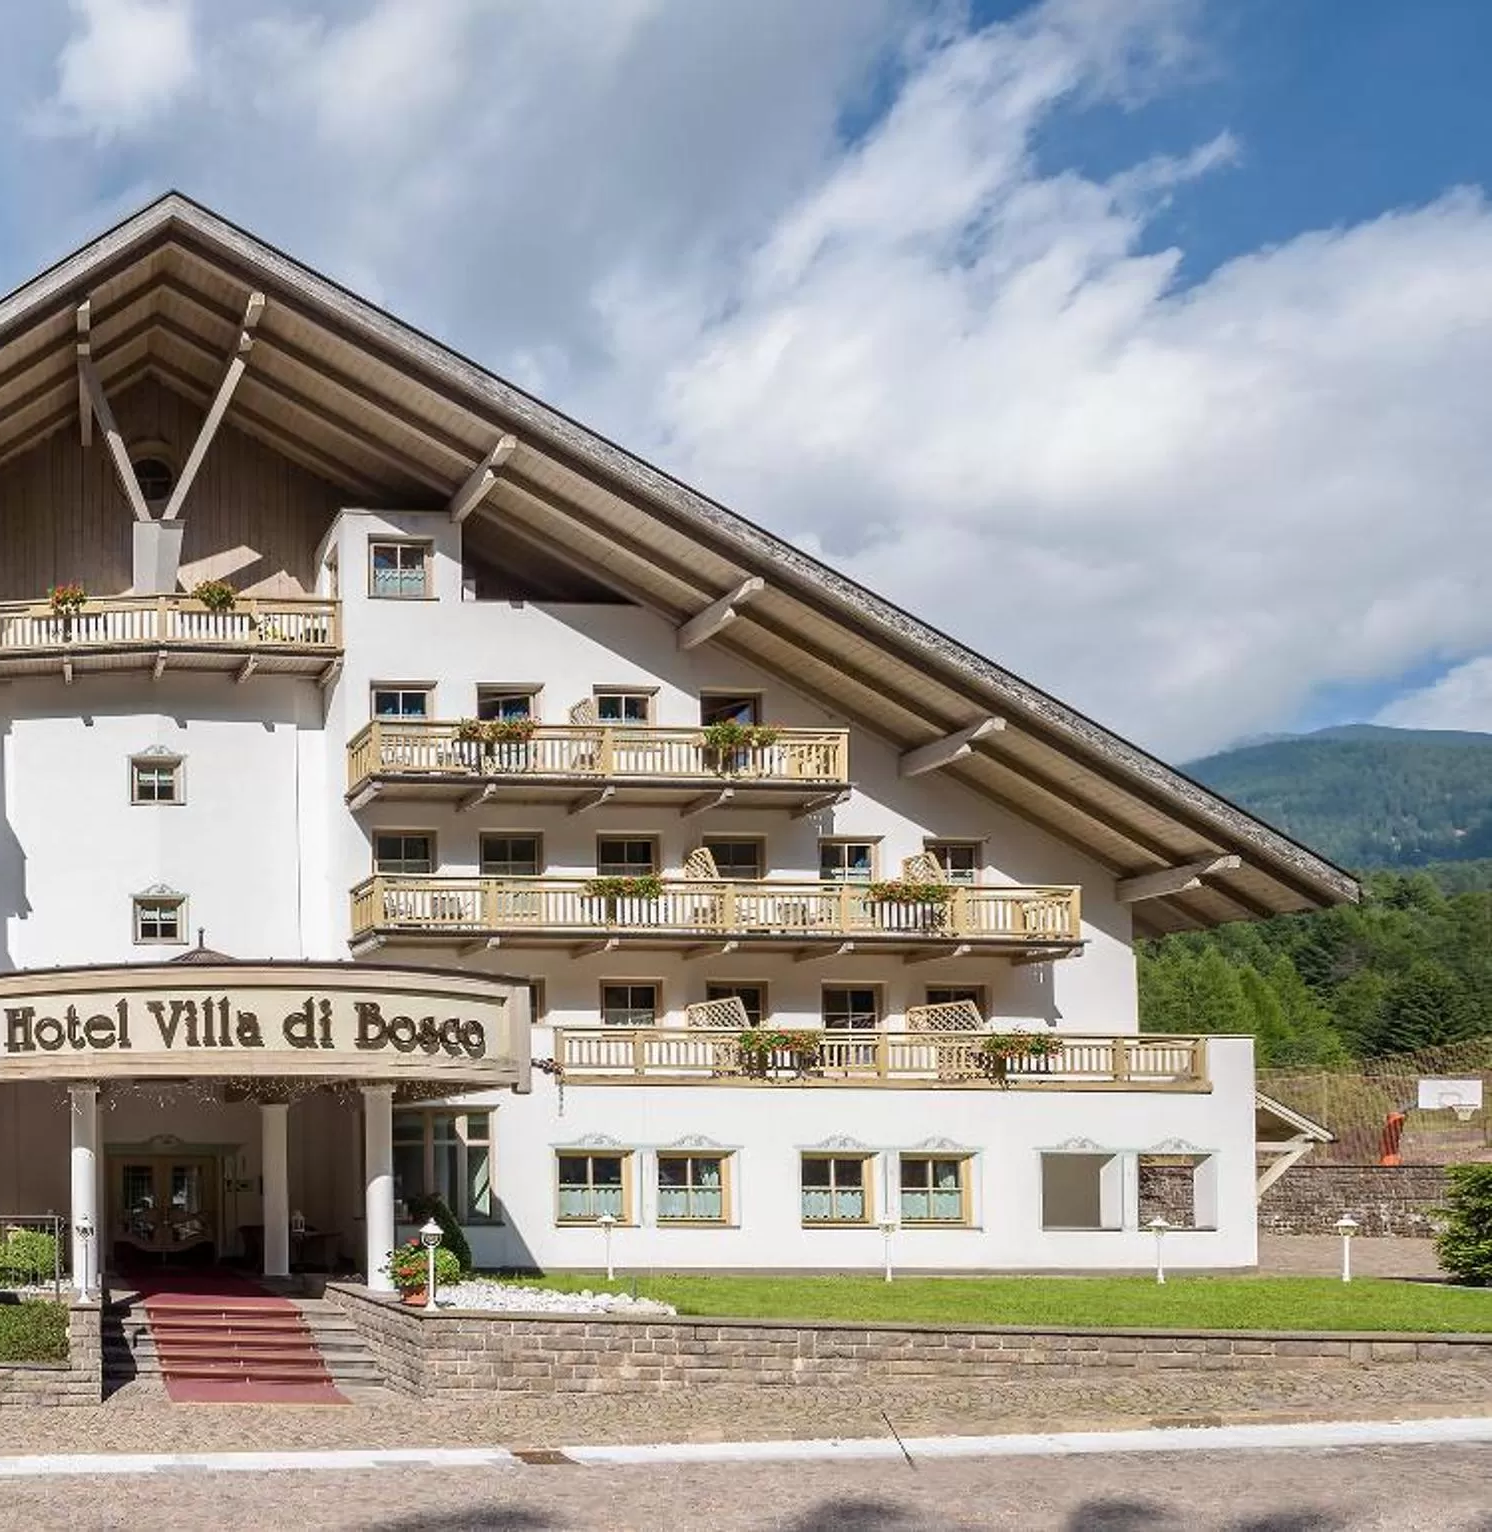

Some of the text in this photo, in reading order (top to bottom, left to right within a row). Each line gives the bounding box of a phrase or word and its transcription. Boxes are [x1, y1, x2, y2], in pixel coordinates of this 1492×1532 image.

[4, 996, 486, 1060] Hotel Villa di Bosco
